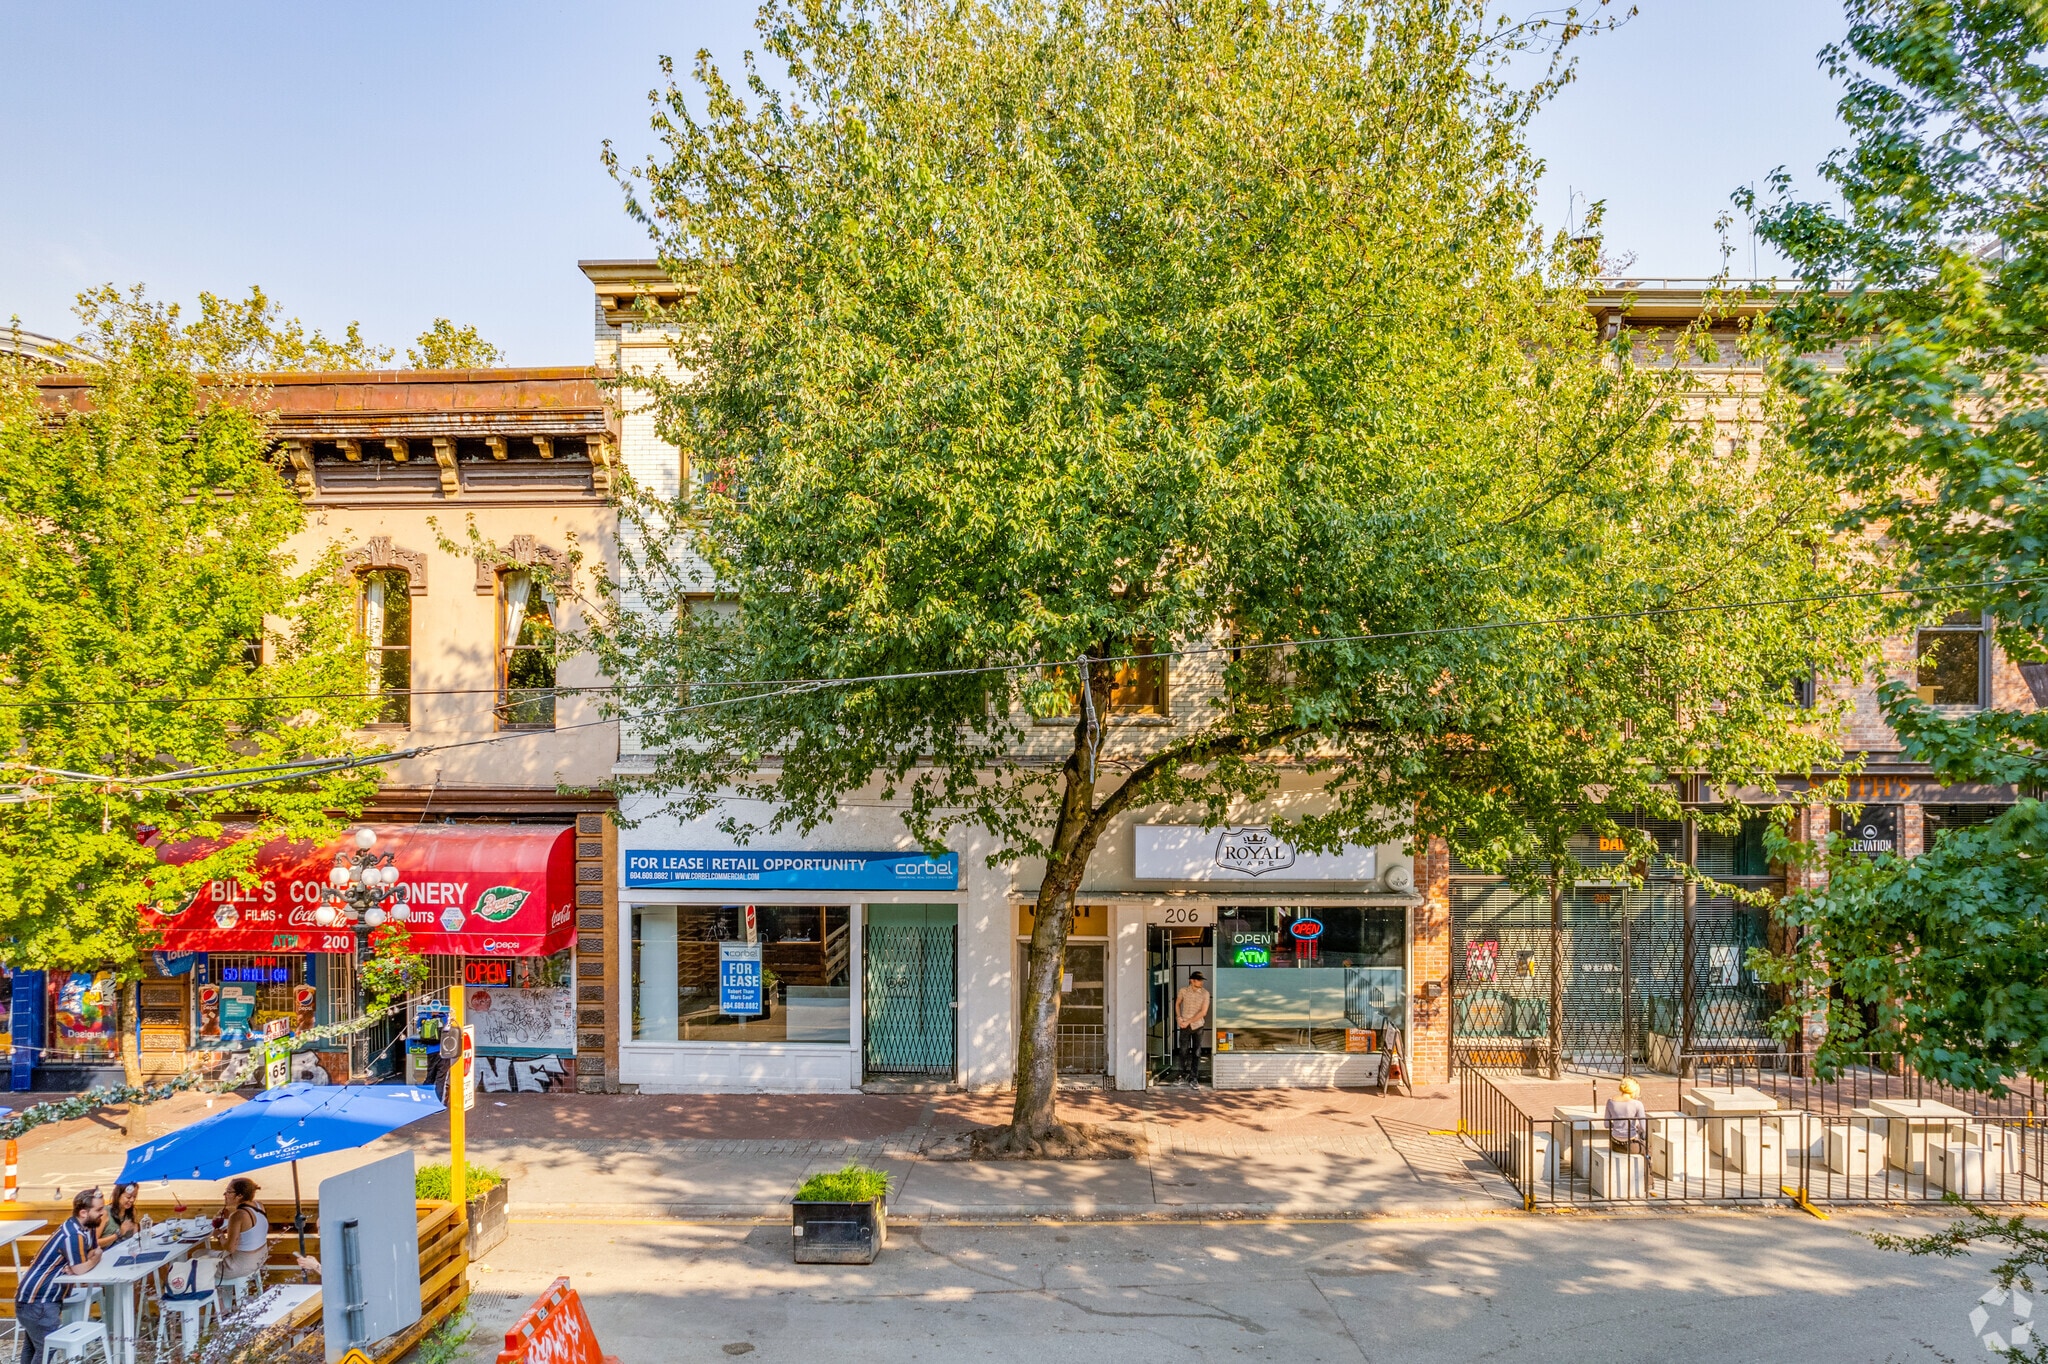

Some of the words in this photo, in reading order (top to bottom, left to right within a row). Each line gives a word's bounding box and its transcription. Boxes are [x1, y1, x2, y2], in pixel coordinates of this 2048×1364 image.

[1849, 839, 1892, 852] ELEVATION
[1225, 845, 1286, 860] ROYAL
[630, 857, 658, 869] FOR
[662, 857, 704, 870] LEASE
[712, 858, 760, 870] RETAIL
[763, 859, 867, 871] OPPORTUNITY
[895, 860, 953, 875] corbel
[675, 872, 760, 881] WWW.CORBELCOMMERCIAL.COM
[211, 879, 277, 903] BILLS
[290, 880, 468, 905] CONFTIONERY
[245, 909, 276, 921] FILMS
[1164, 908, 1199, 924] 206
[1293, 922, 1321, 935] OPEN
[272, 934, 299, 948] ATM
[322, 935, 349, 949] 200
[1234, 934, 1271, 944] OPEN
[496, 942, 520, 950] pepsi
[255, 957, 277, 966] ATM
[1236, 951, 1268, 963] ATM
[465, 963, 508, 984] OPEN
[729, 963, 752, 974] FOR
[723, 975, 759, 987] LEASE
[266, 1018, 288, 1035] ATM
[272, 1062, 286, 1079] 65
[253, 1148, 282, 1160] GREY
[283, 1140, 322, 1153] GOOSE
[275, 1150, 301, 1158] VODKA
